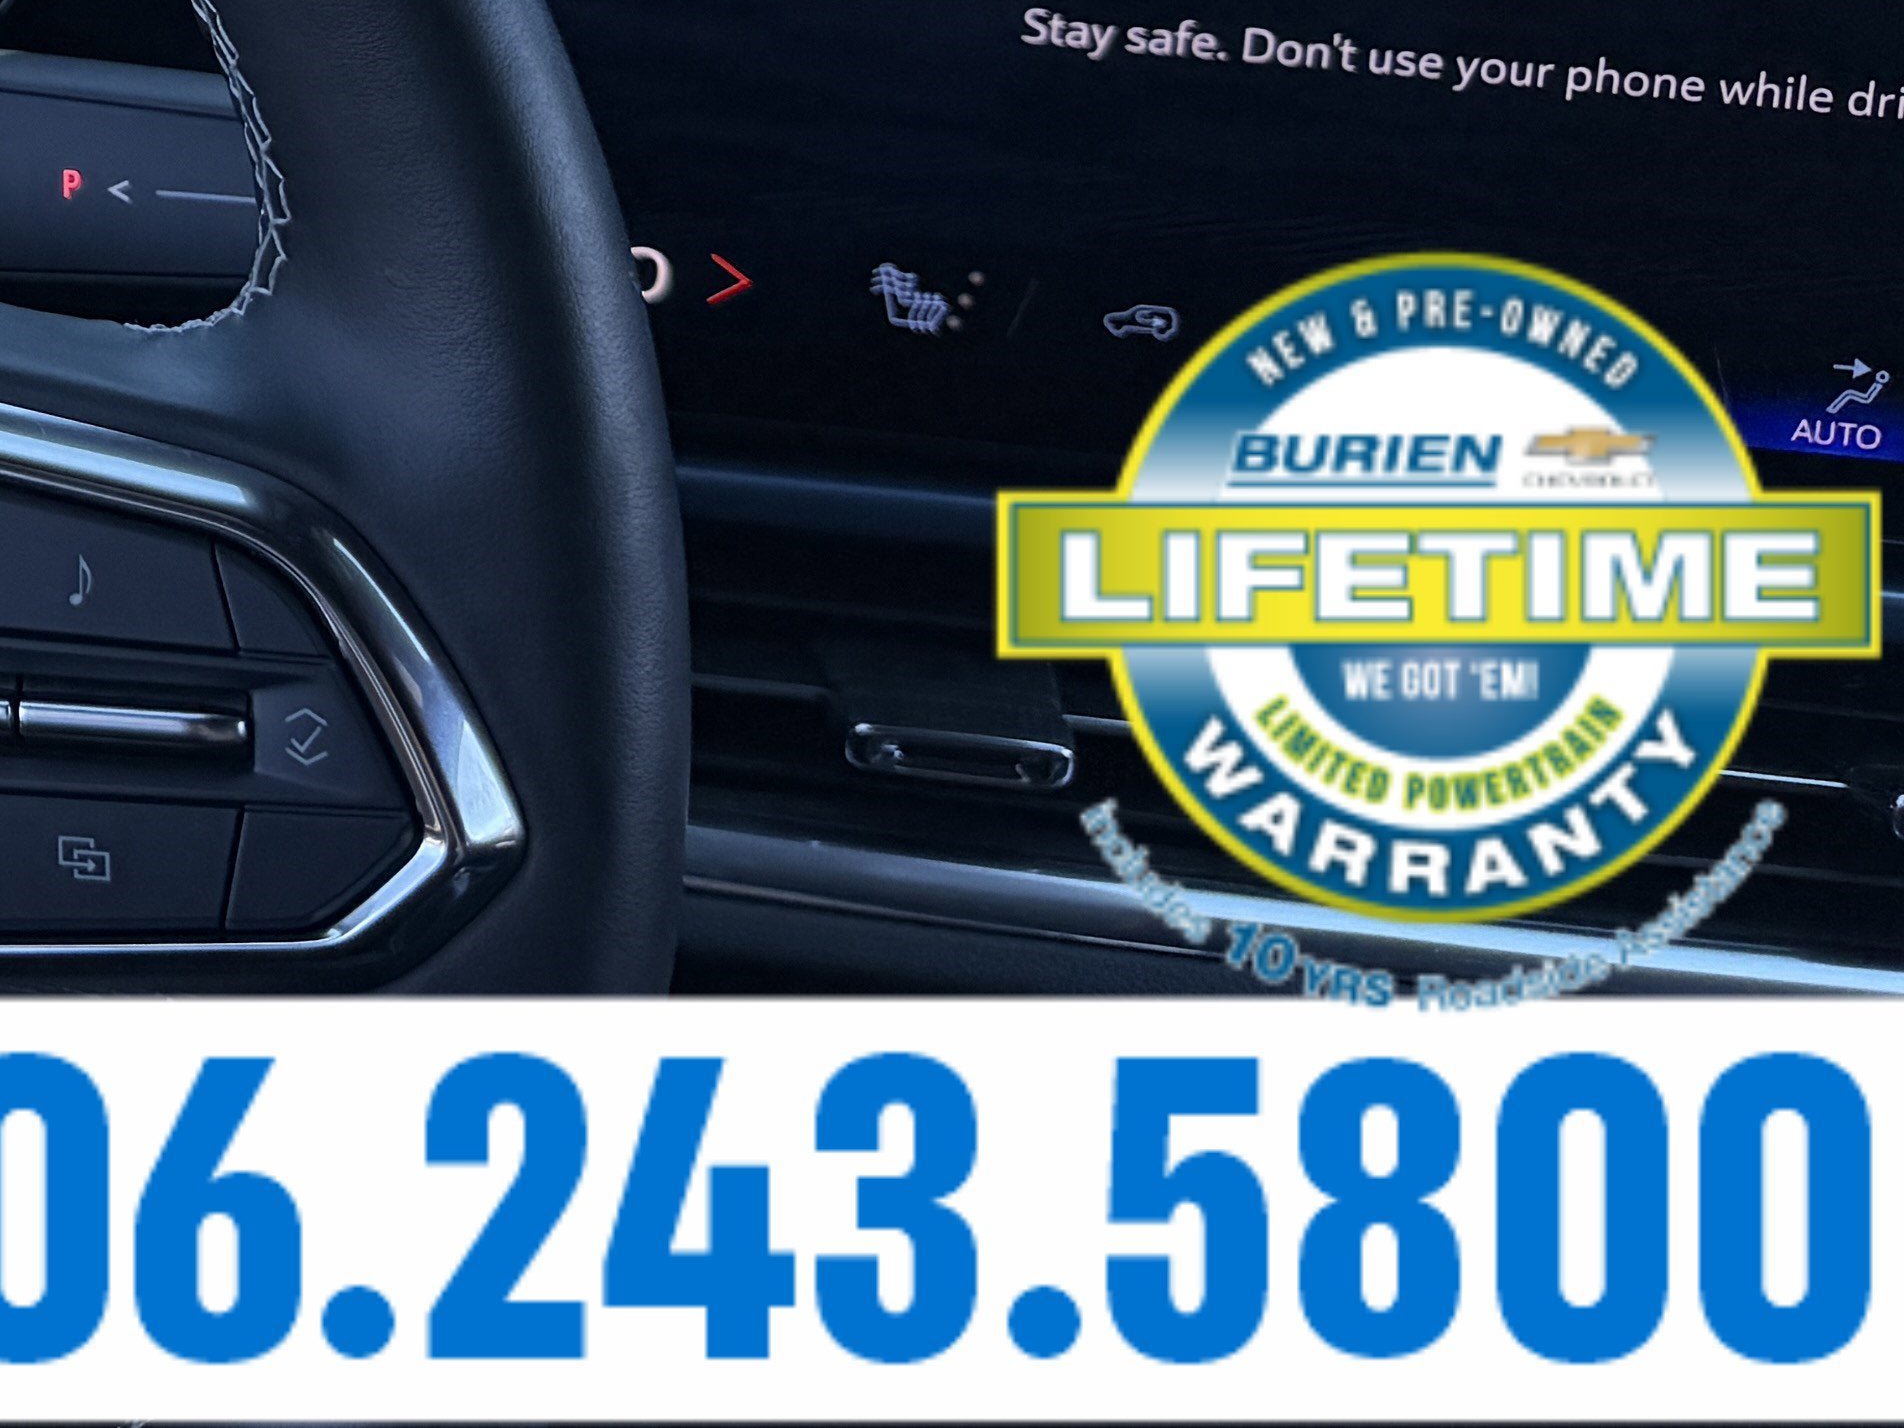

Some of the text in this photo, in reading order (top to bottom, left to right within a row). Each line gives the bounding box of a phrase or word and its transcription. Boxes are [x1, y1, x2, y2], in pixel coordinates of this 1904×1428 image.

[1019, 7, 1115, 60] Stay
[1124, 19, 1229, 63] safe.
[1241, 28, 1359, 74] Don't
[1367, 48, 1443, 82] use
[1451, 58, 1555, 93] your
[1565, 58, 1705, 105] phone
[1718, 70, 1834, 117] while
[61, 168, 82, 200] P
[1791, 418, 1882, 450] AUTO
